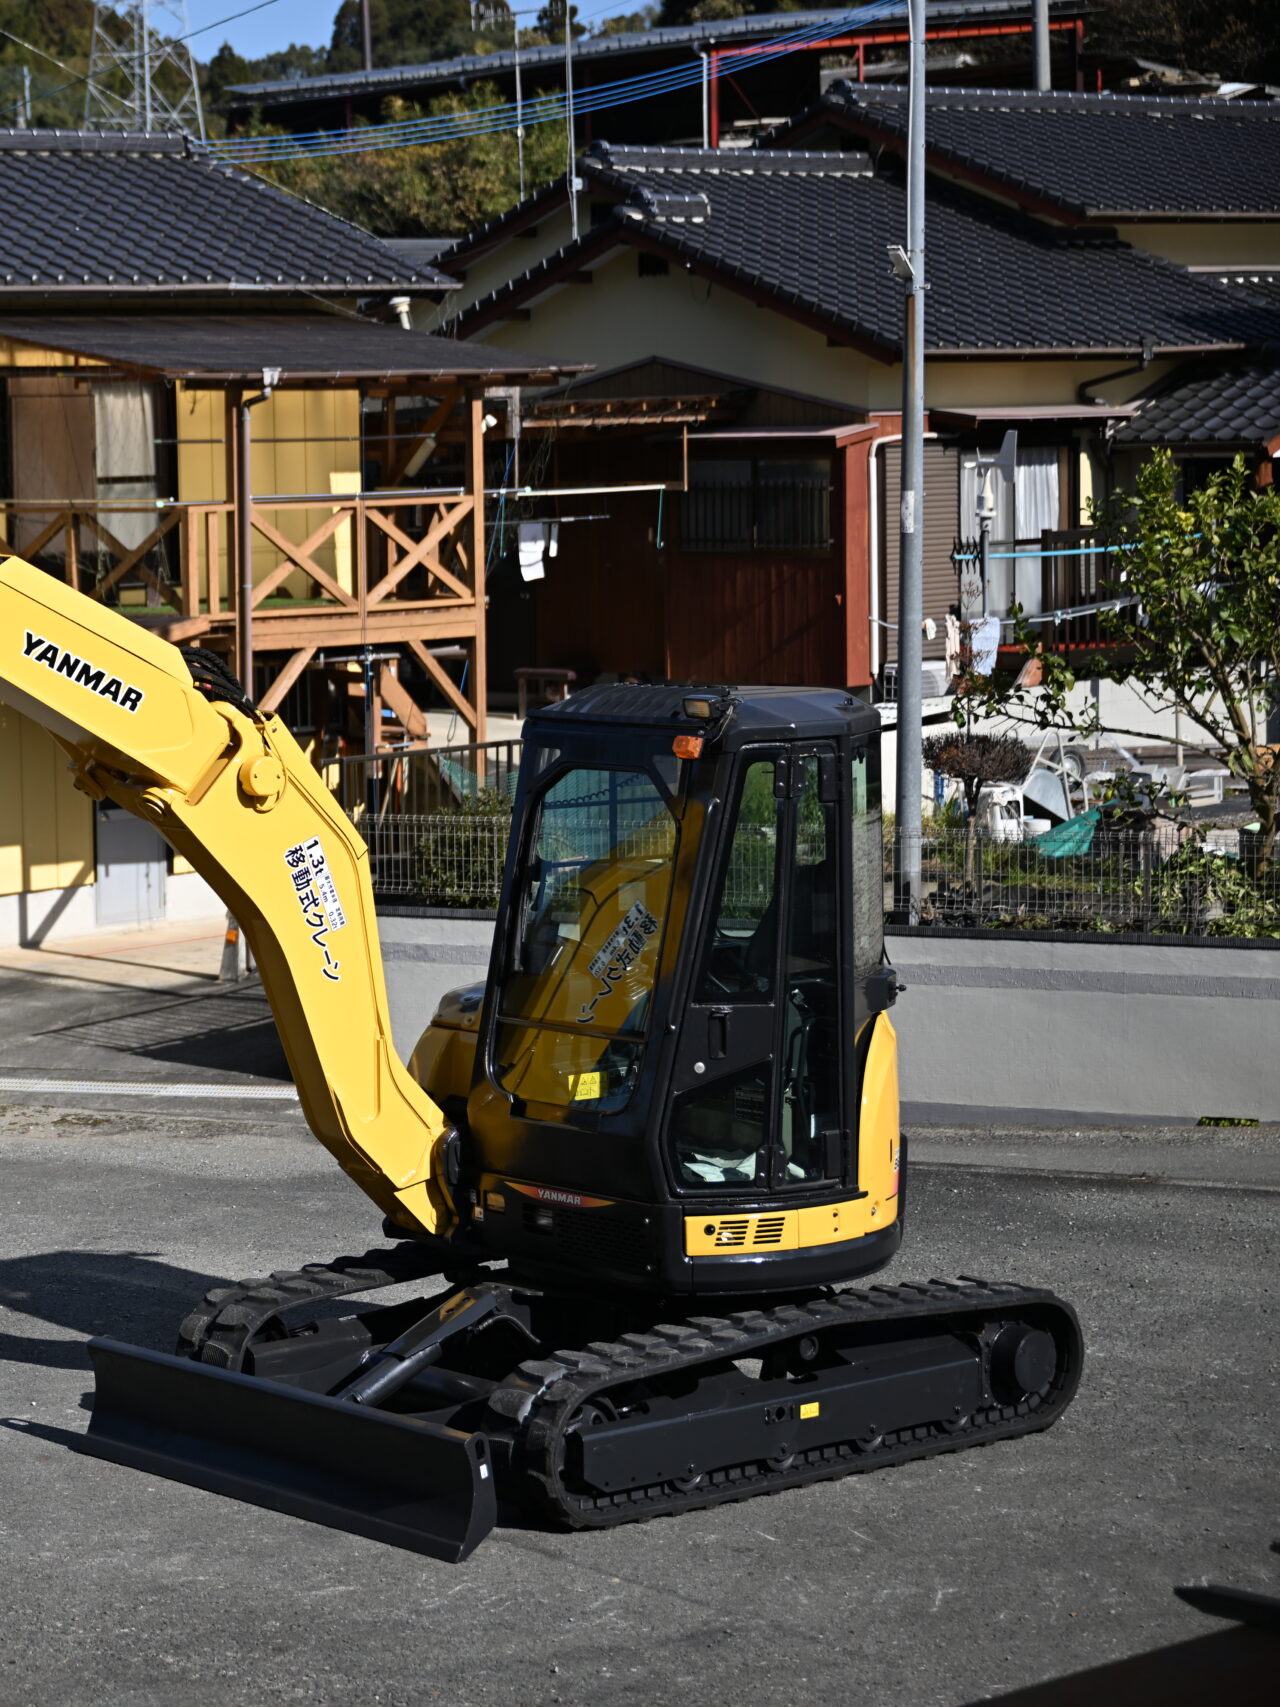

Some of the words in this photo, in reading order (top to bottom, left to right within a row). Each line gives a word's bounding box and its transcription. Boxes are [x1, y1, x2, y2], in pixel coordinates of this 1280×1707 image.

[23, 631, 143, 712] YANMAR
[306, 839, 325, 877] 1.3t
[285, 845, 339, 981] 移動式クレーン
[537, 1189, 581, 1205] YANMAR
